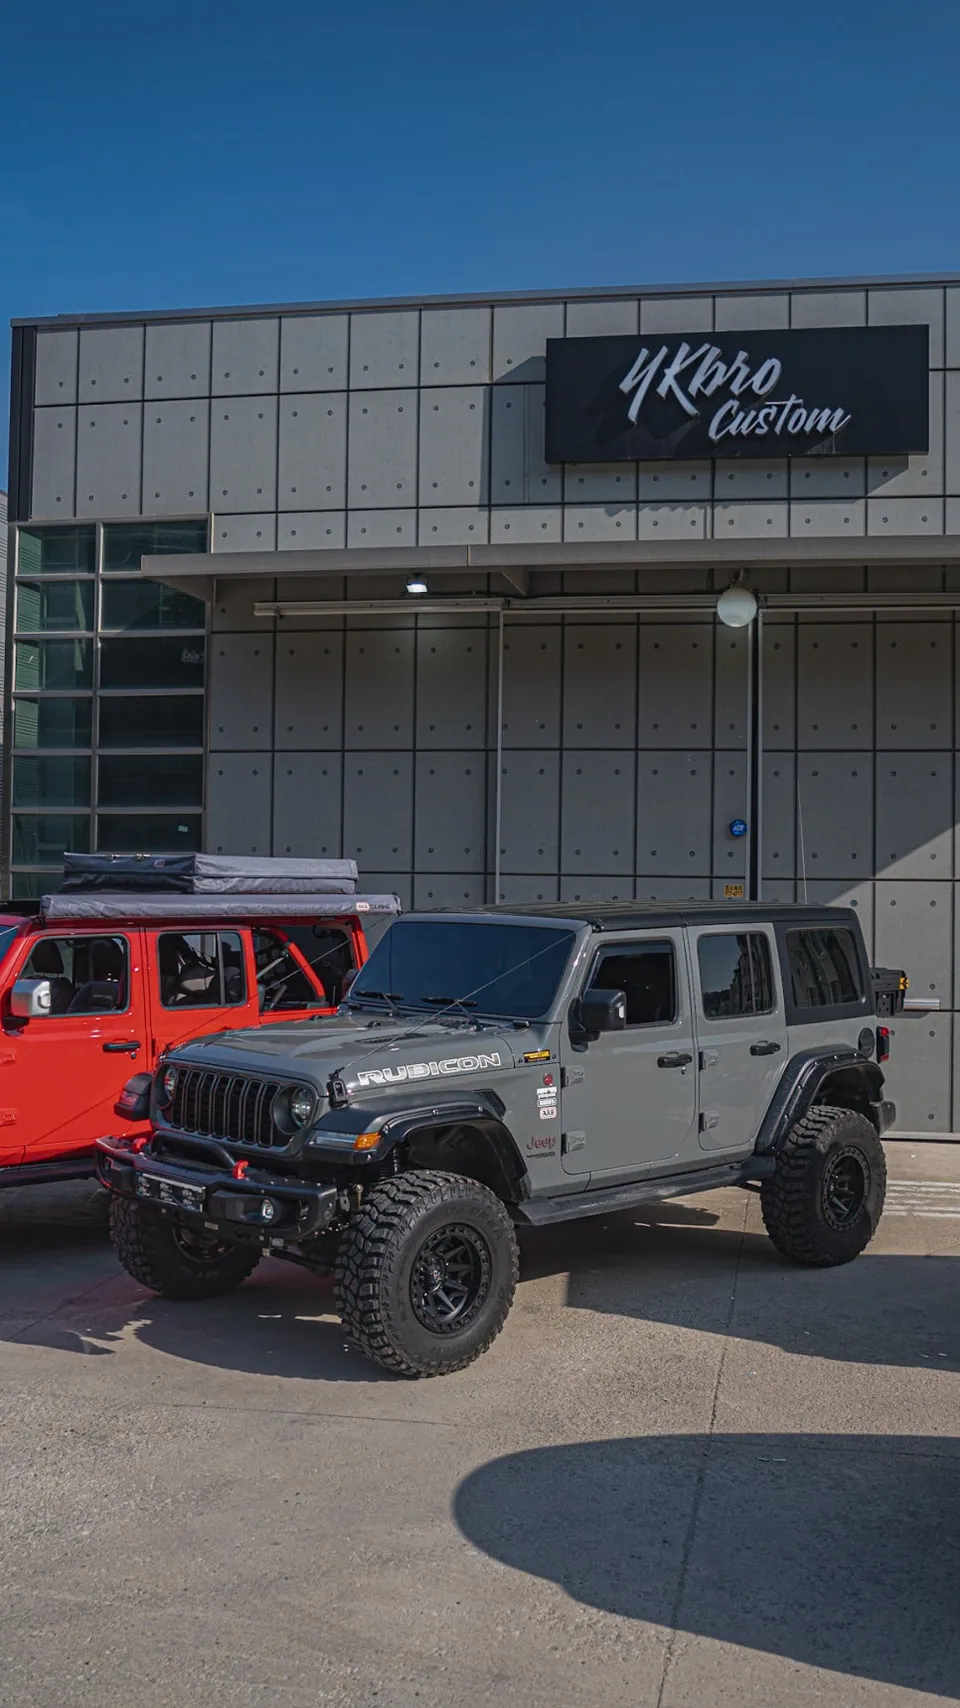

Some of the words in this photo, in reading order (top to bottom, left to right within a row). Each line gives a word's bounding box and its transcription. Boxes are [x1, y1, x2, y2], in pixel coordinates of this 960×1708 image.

[708, 394, 852, 442] Custom
[358, 1053, 501, 1086] RUBICON
[526, 1136, 557, 1150] Jeep
